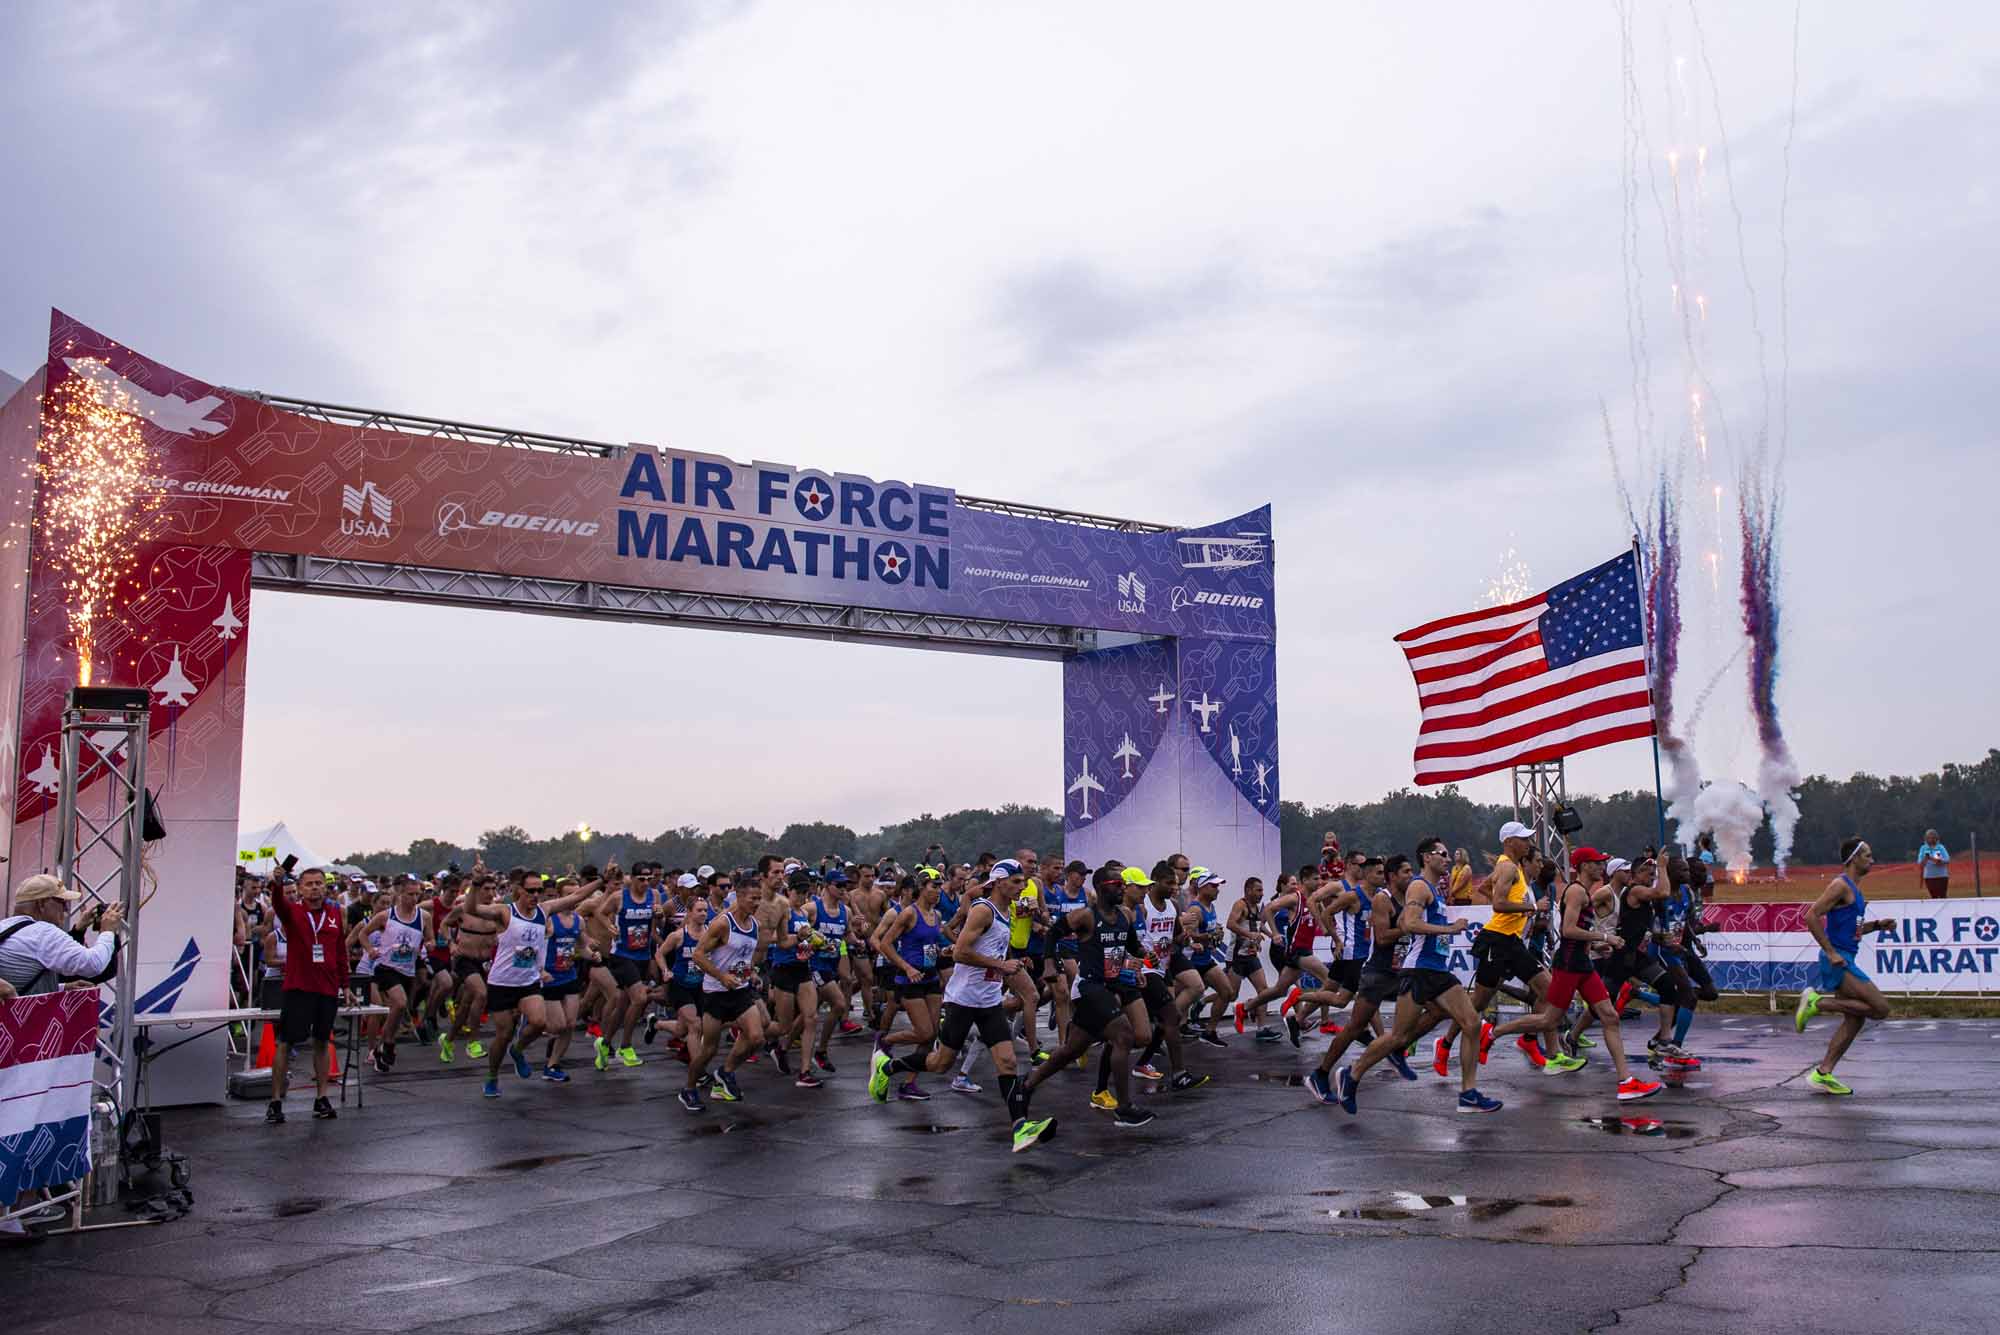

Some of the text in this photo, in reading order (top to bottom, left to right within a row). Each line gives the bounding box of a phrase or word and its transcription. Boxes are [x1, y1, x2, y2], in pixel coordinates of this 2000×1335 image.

[183, 481, 291, 501] GRUMMAN
[619, 452, 950, 538] AIR FORCE
[341, 518, 391, 538] USAA
[478, 510, 600, 537] BOEING
[617, 509, 950, 590] MARATHON
[964, 567, 1089, 588] NORTHROP GRUMMAN
[1118, 599, 1145, 614] USAA
[1193, 591, 1264, 609] BOEING
[1876, 918, 1939, 943] AIR
[1703, 940, 1760, 951] thon.com
[1876, 947, 1999, 974] MARAT
